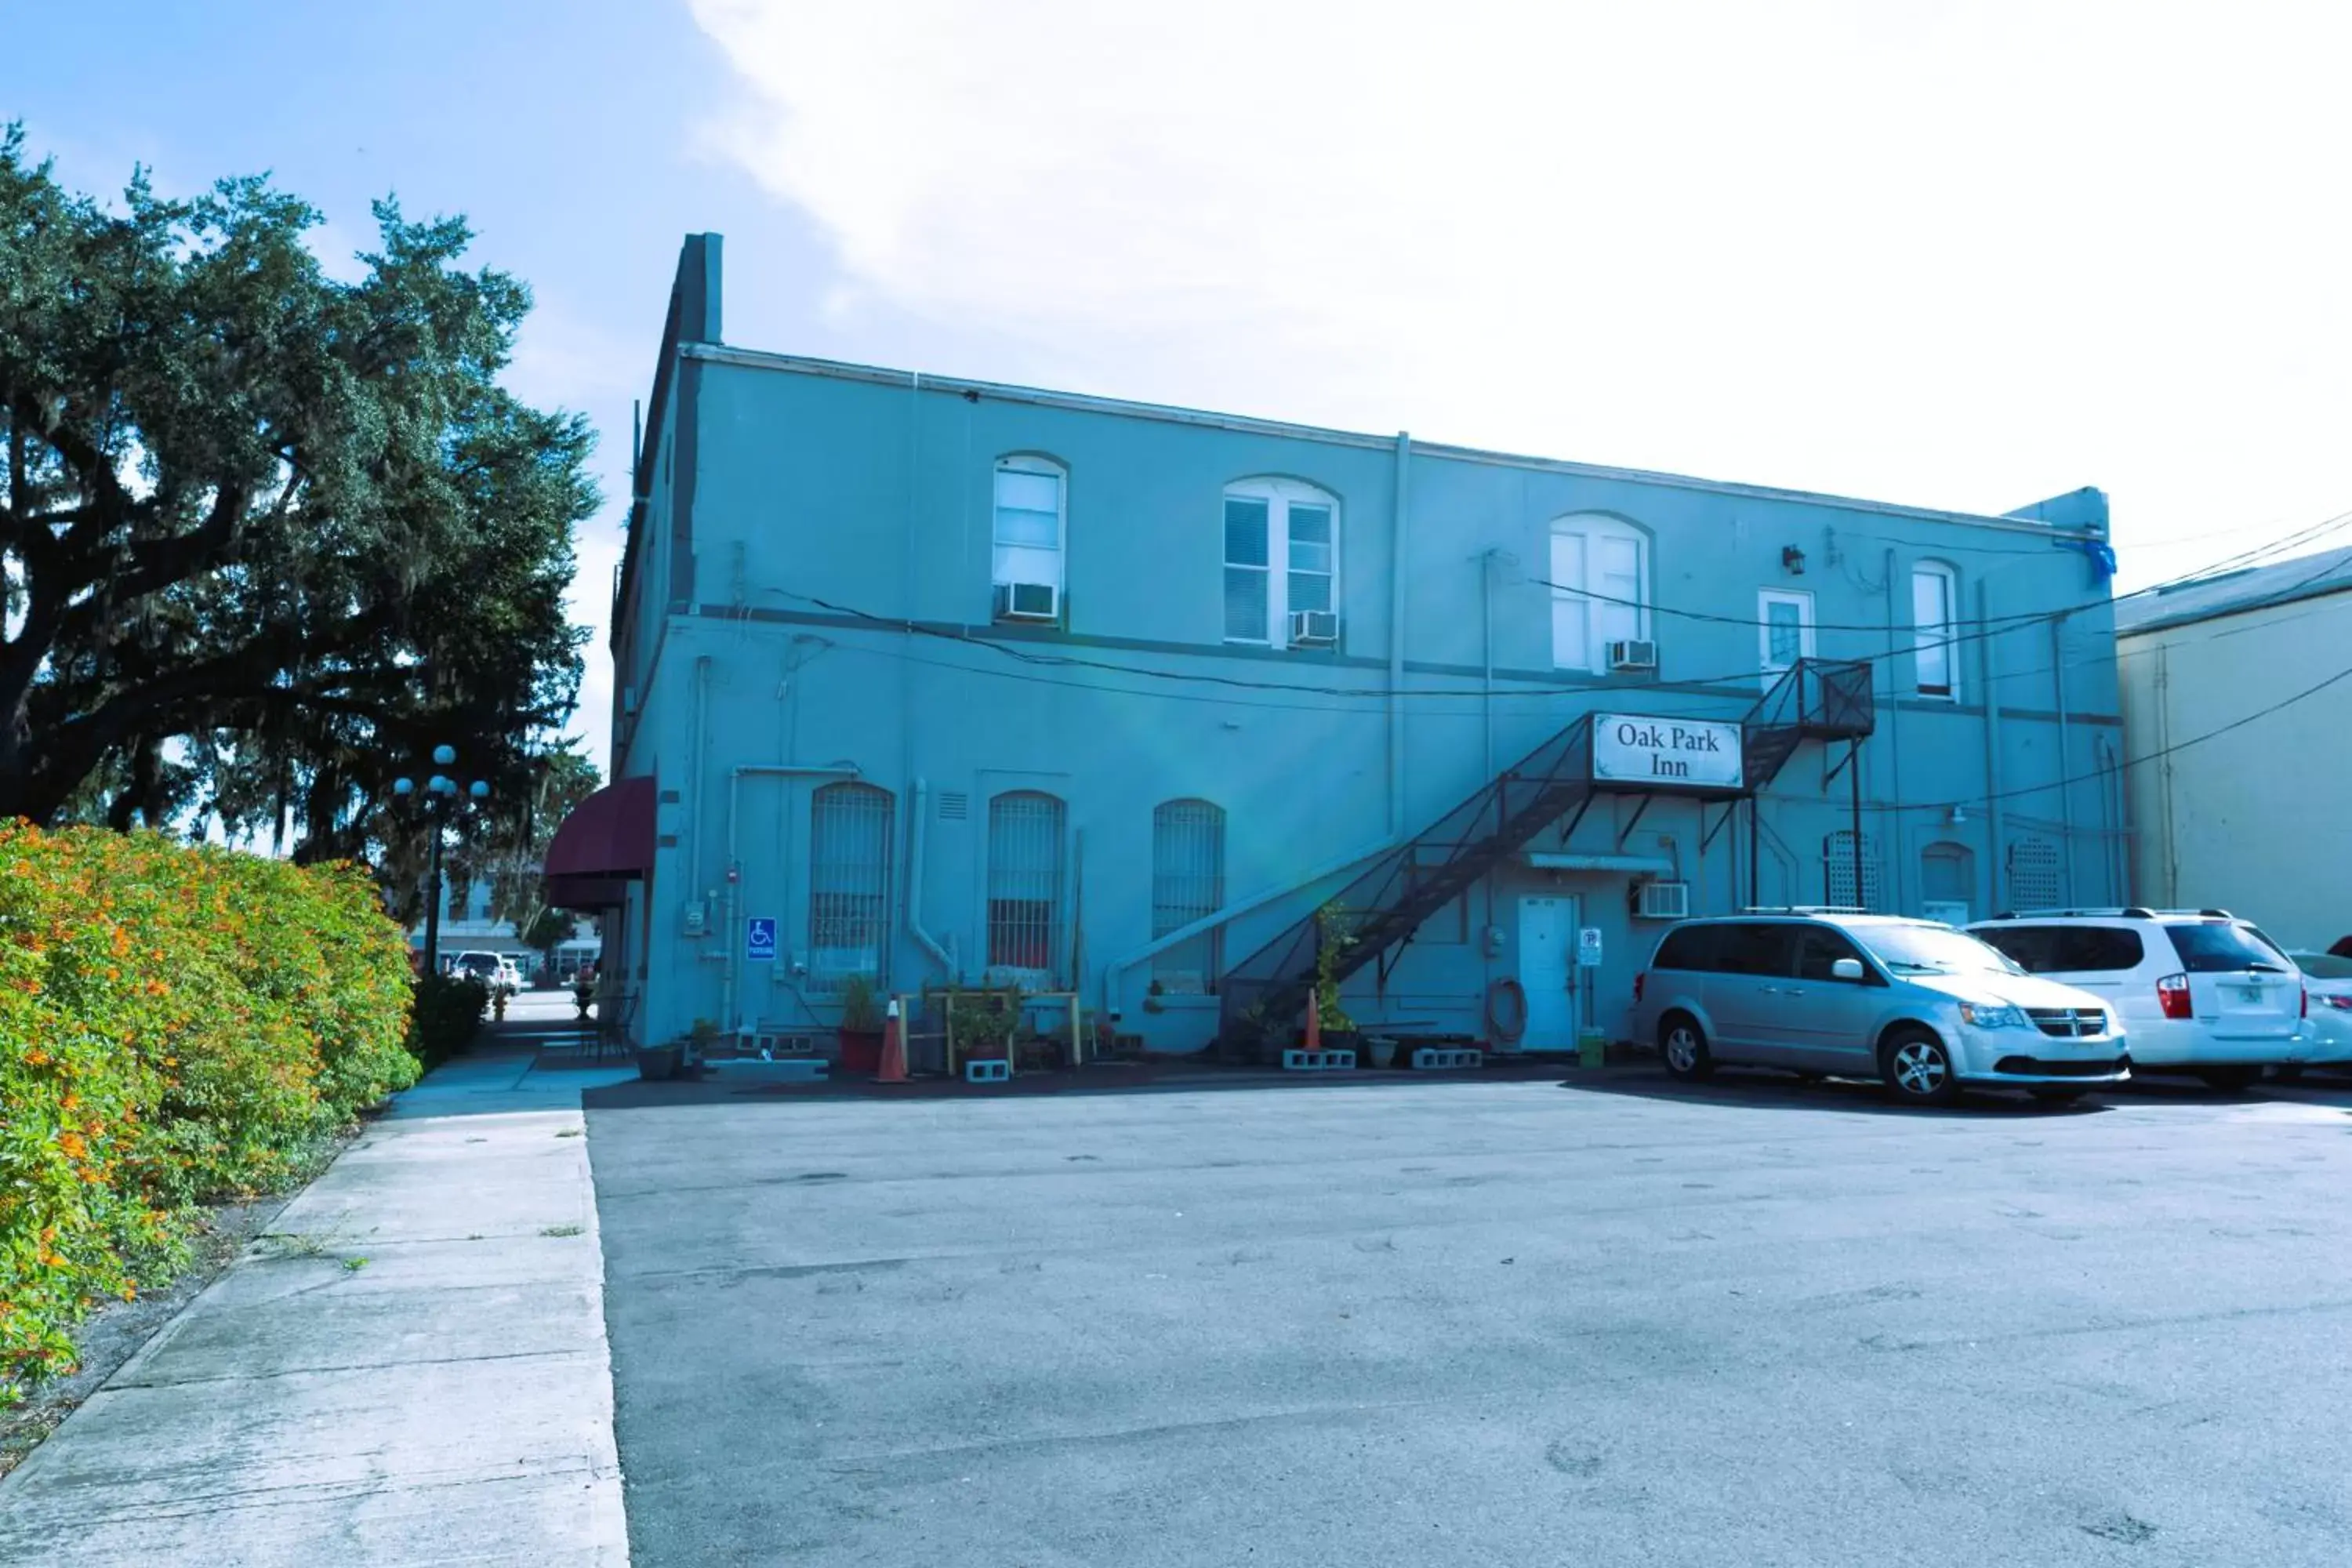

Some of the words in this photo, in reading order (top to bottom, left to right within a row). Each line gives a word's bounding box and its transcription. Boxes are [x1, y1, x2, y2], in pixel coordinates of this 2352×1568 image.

[1617, 723, 1664, 748] Oak
[1671, 728, 1719, 752] Park
[1651, 753, 1688, 777] Inn
